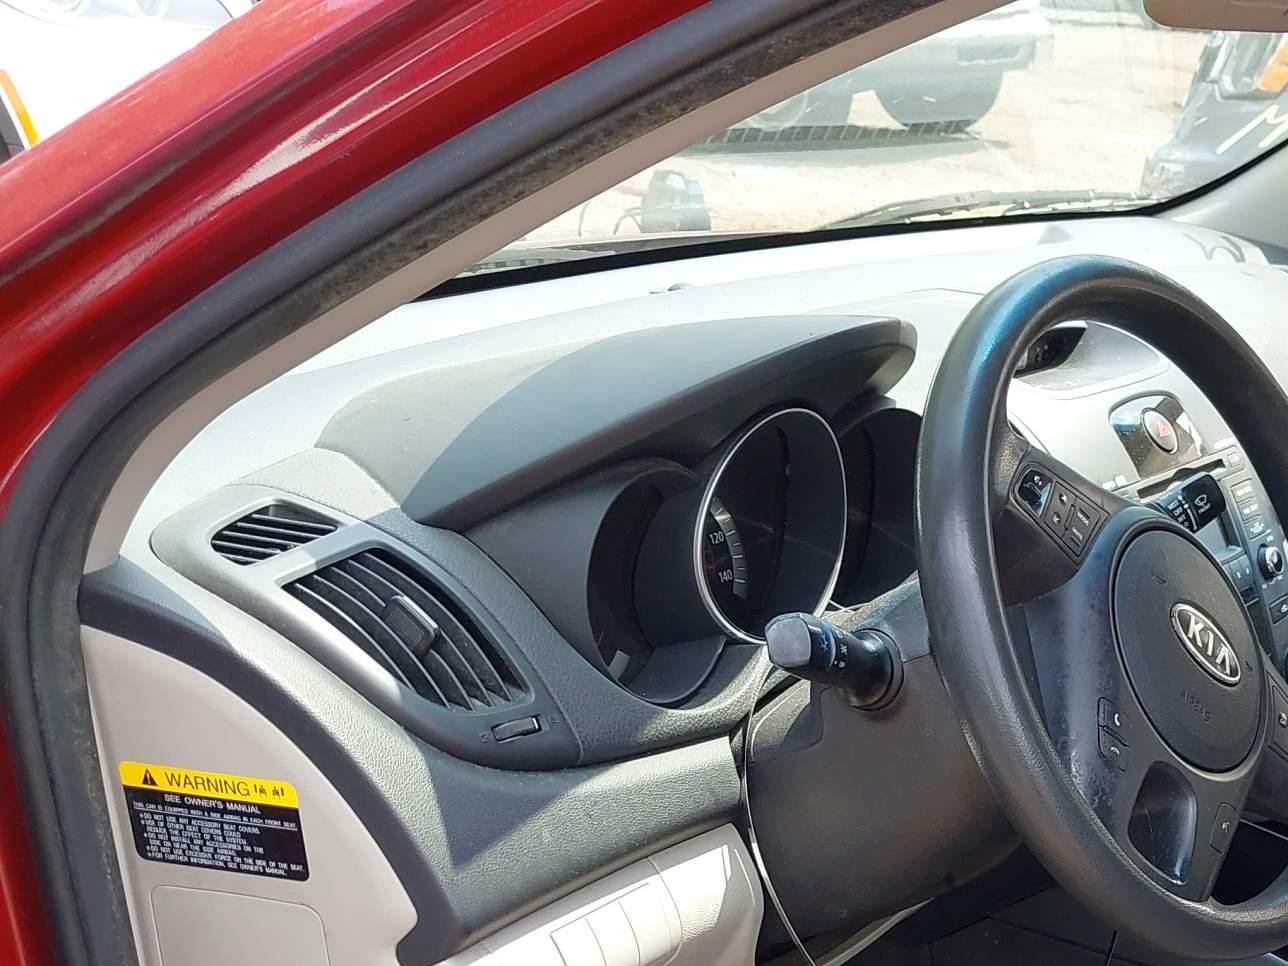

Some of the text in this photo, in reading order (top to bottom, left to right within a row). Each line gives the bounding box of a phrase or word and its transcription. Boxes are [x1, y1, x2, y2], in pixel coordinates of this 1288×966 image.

[709, 530, 724, 545] 120
[718, 568, 733, 583] 140
[1186, 612, 1231, 676] KIA
[164, 770, 251, 797] WARNING
[163, 794, 260, 813] SEE OWNER'S MANUAL
